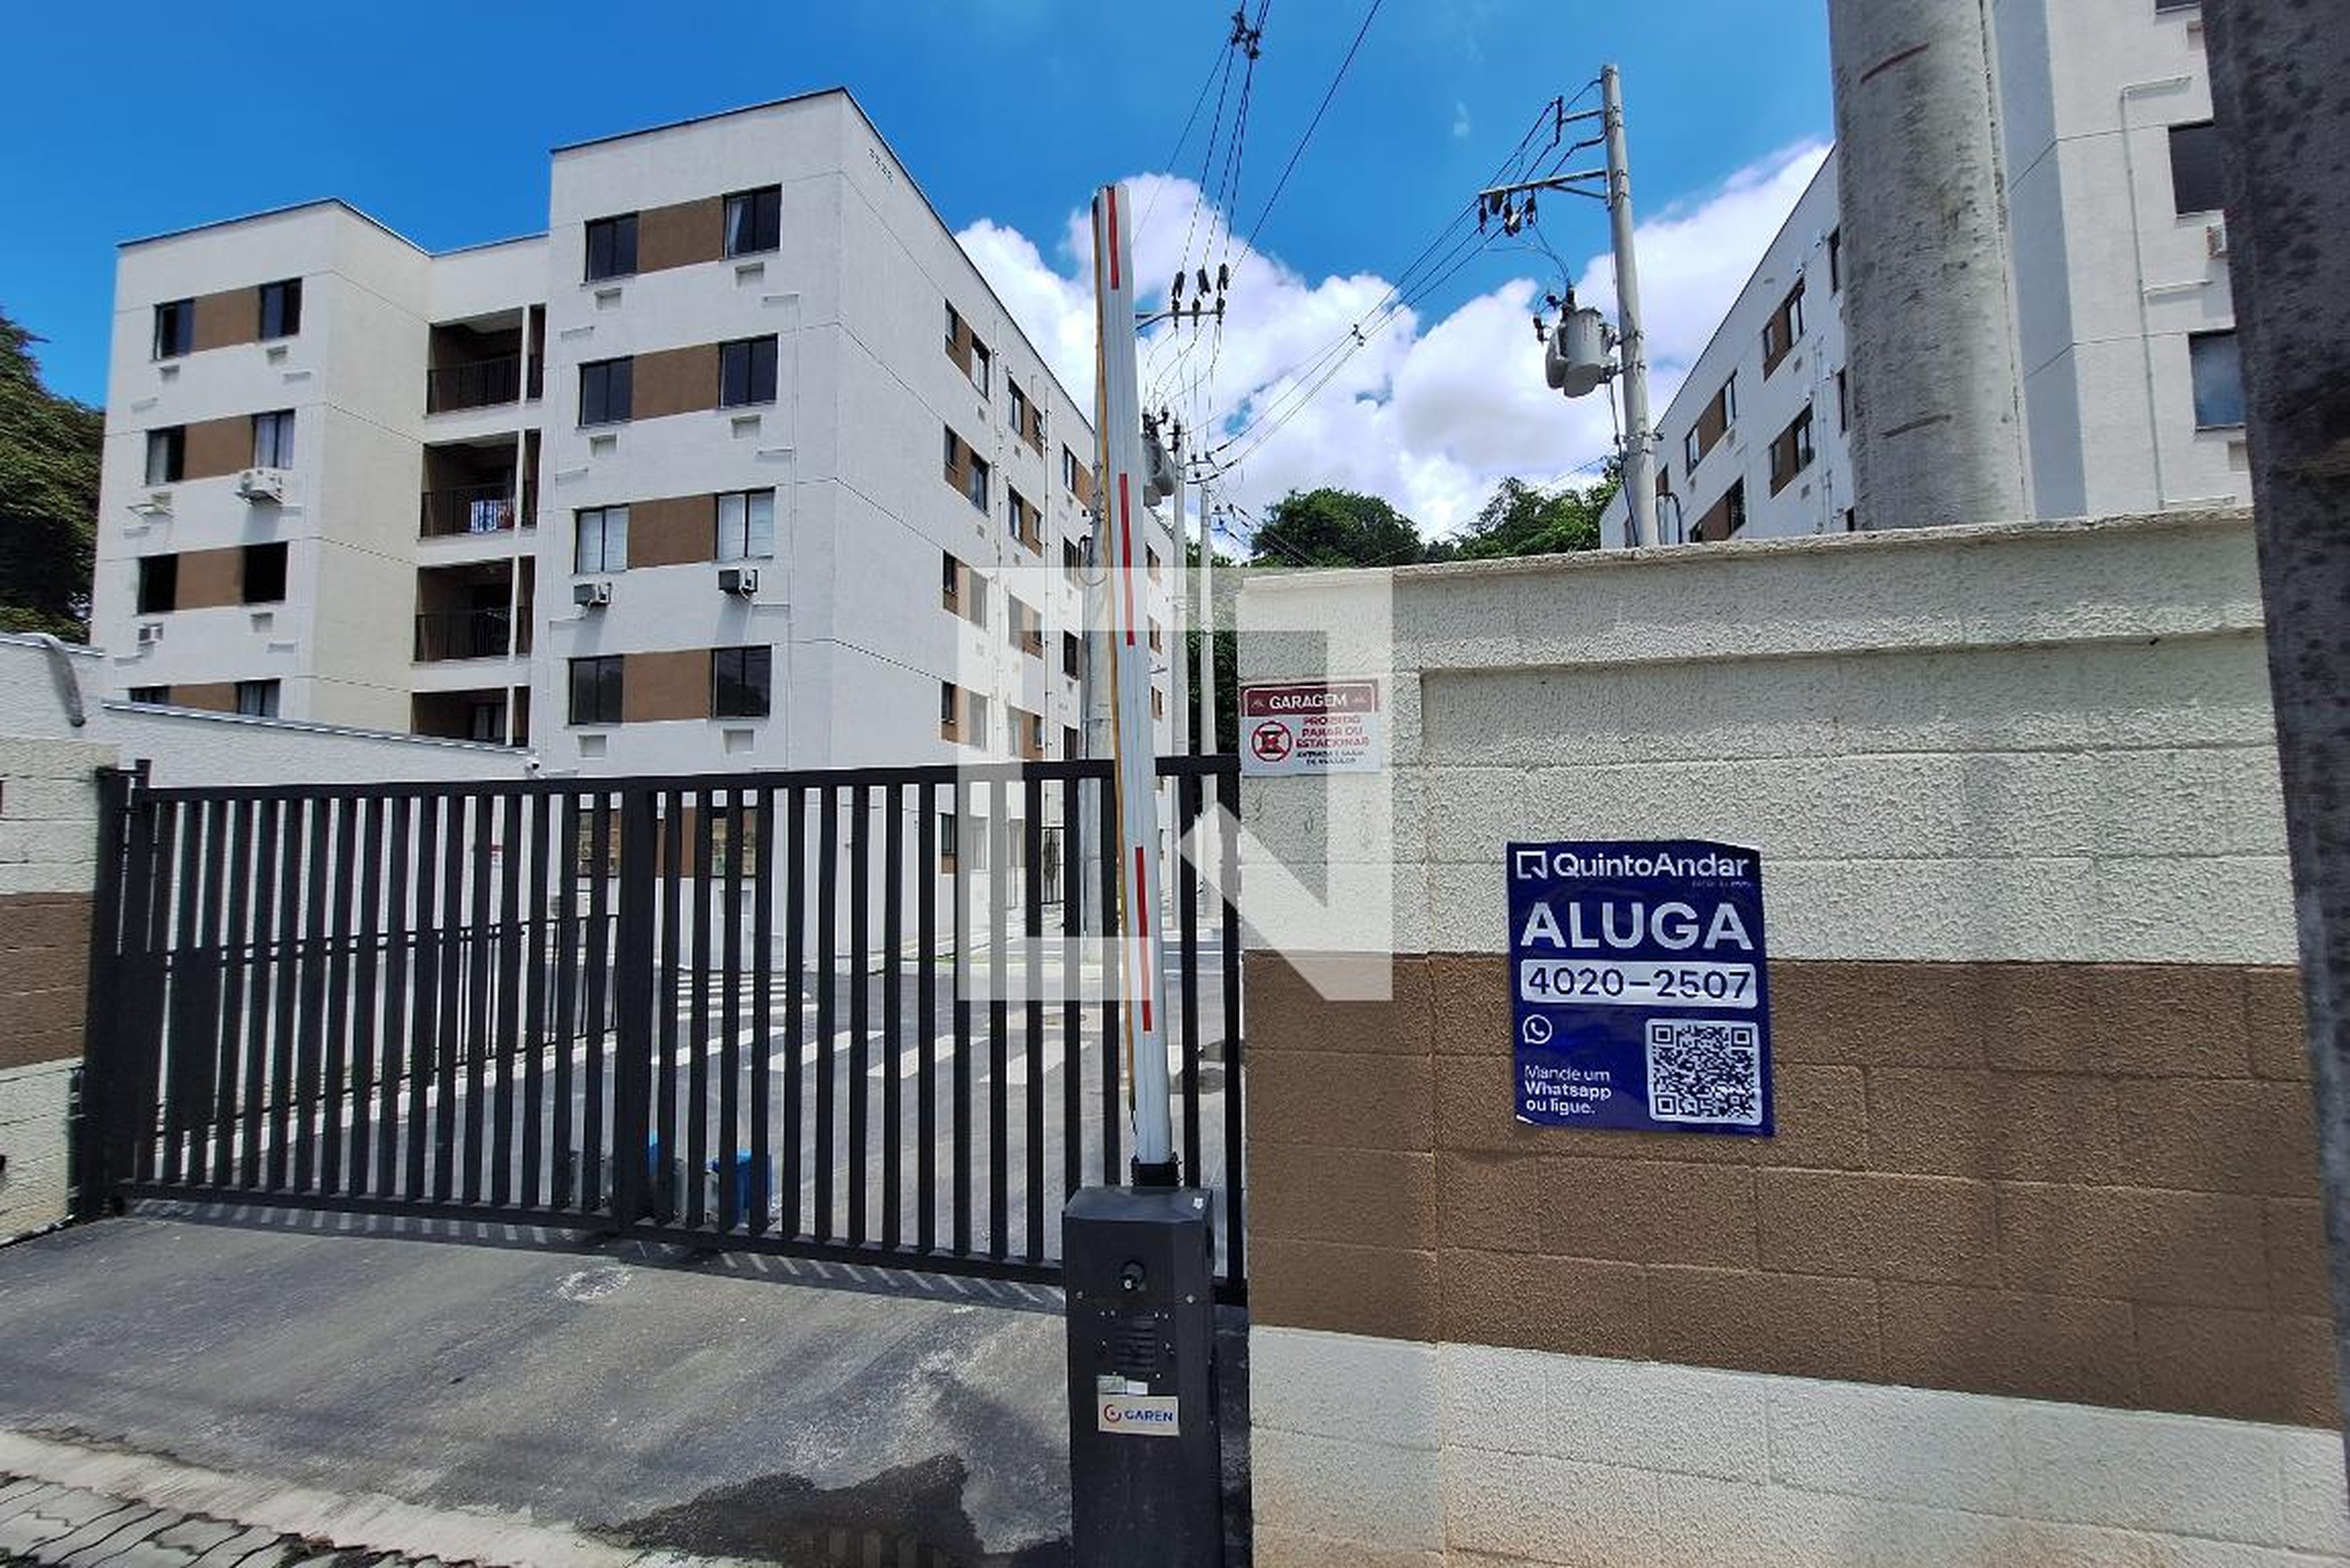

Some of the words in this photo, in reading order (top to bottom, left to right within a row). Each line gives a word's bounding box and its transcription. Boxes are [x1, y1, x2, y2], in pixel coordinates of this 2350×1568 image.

[1270, 694, 1347, 709] GARAGEM
[1553, 853, 1750, 877] QuintoAndar
[1520, 902, 1755, 950] ALUGA
[1529, 967, 1751, 999] 4020-2507
[1524, 1065, 1582, 1081] Mande
[1584, 1069, 1611, 1081] um
[1525, 1081, 1612, 1100] Whatsapp
[1526, 1099, 1546, 1112] ou
[1550, 1097, 1595, 1116] ligue.
[1125, 1410, 1173, 1422] GAREN
